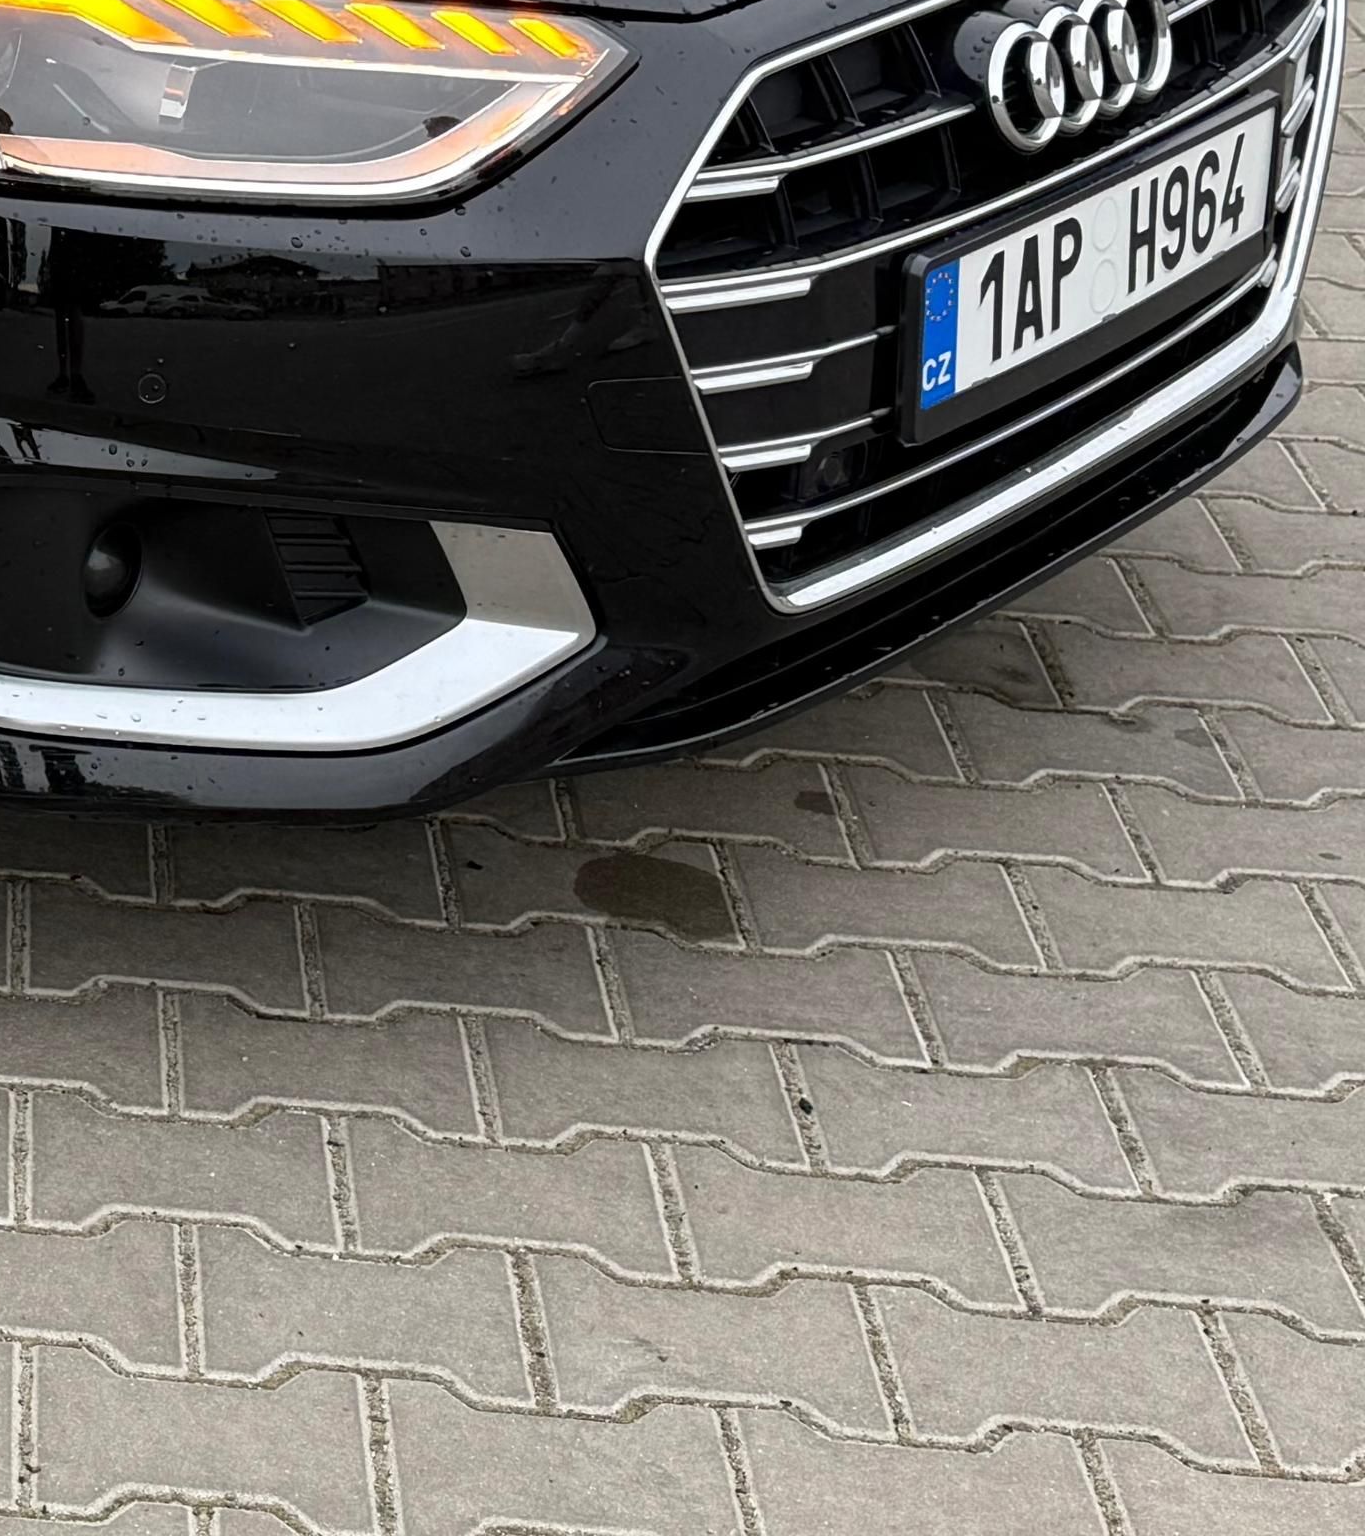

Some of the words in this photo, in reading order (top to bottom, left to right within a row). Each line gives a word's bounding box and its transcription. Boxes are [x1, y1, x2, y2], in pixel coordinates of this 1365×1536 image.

[979, 216, 1083, 364] 1AP
[1126, 132, 1246, 296] H964
[922, 350, 952, 392] CZ
